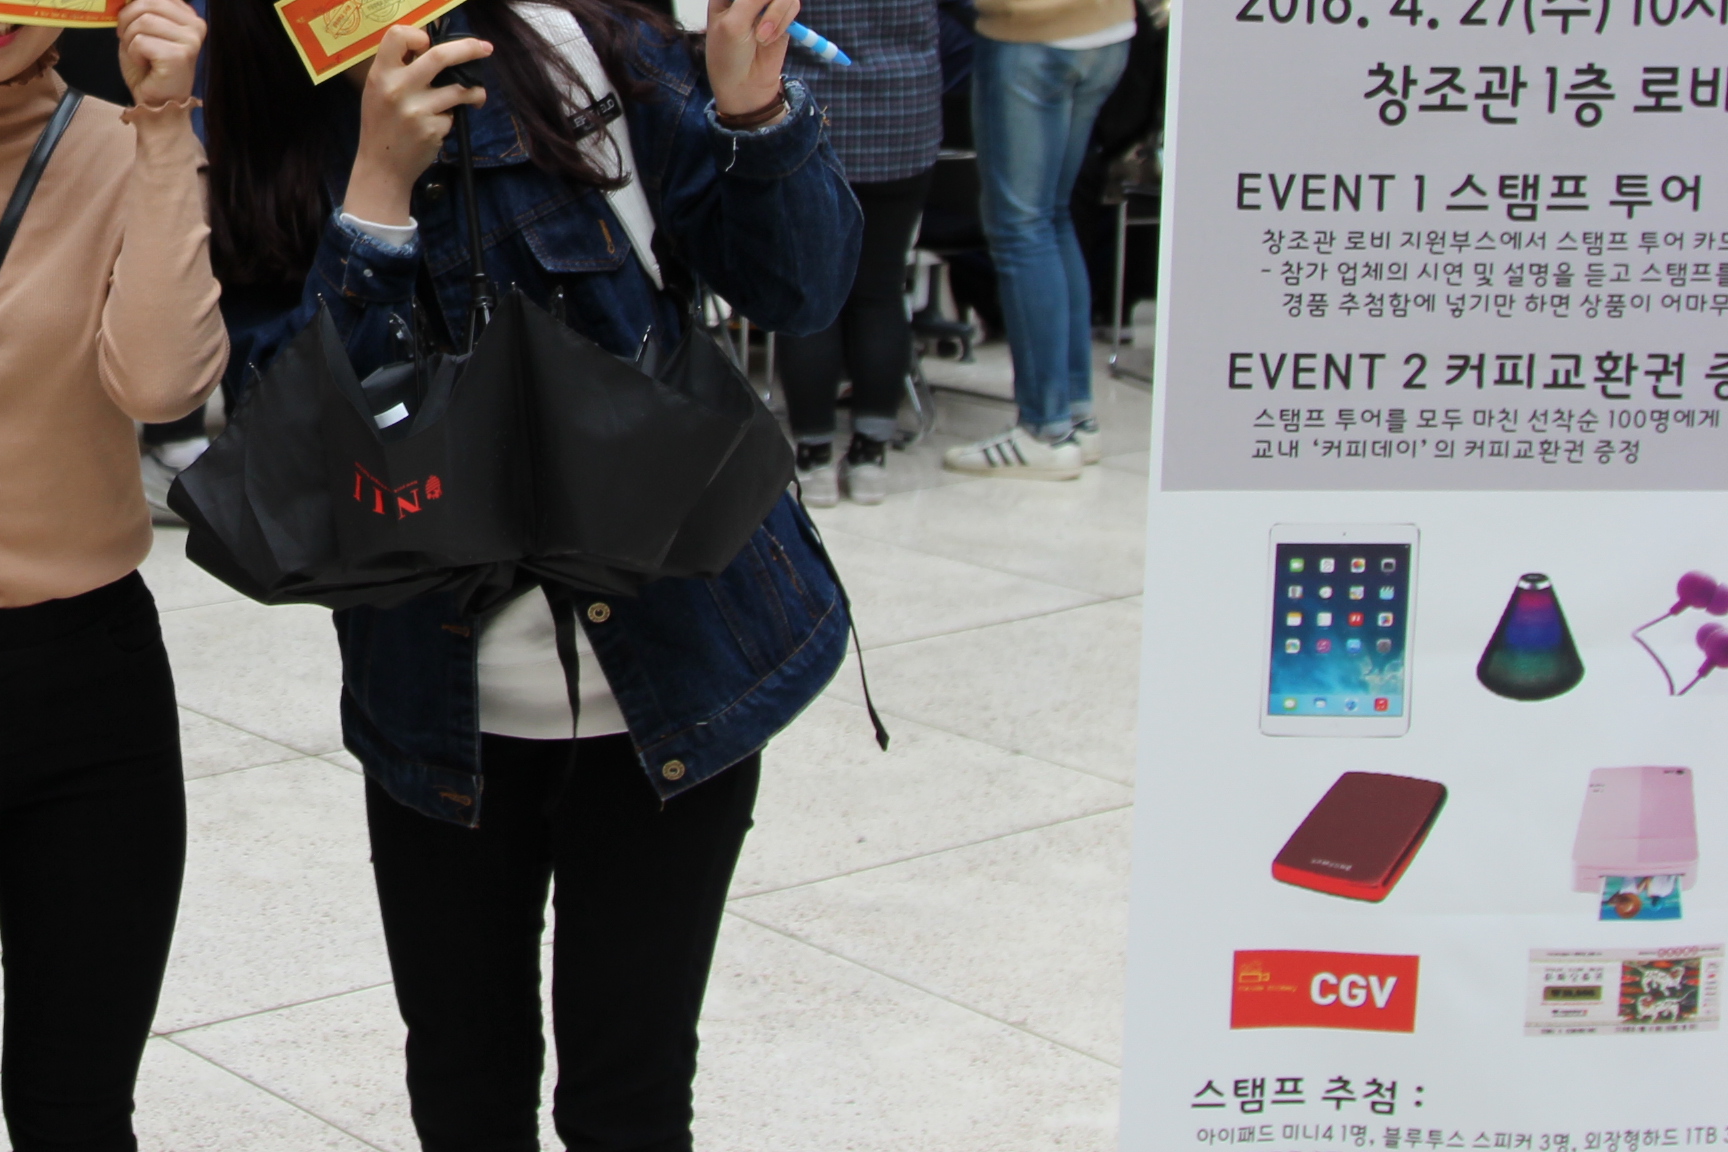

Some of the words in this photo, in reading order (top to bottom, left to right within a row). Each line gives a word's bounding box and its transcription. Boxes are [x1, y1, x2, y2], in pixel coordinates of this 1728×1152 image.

[1364, 61, 1528, 128] 창조관
[1545, 62, 1617, 128] 1층
[1633, 65, 1728, 115] 로비
[1236, 172, 1396, 213] EVENT
[1414, 173, 1425, 213] 1
[1445, 173, 1590, 223] 스탬프
[1608, 173, 1702, 220] 투어
[1261, 229, 1337, 256] 창조관
[1344, 230, 1391, 252] 로비
[1400, 229, 1547, 256] 지원부스에서
[1556, 230, 1630, 256] 스탬프
[1638, 230, 1685, 256] 투어
[1280, 260, 1328, 287] 참가
[1338, 261, 1408, 287] 업체의
[1417, 261, 1464, 286] 시연
[1474, 262, 1495, 287] 및
[1503, 261, 1575, 288] 설명을
[1583, 262, 1632, 286] 듣고
[1282, 292, 1329, 318] 경품
[1338, 292, 1436, 318] 추첨함에
[1445, 292, 1517, 319] 넣기만
[1524, 293, 1571, 317] 하면
[1579, 292, 1652, 318] 상품이
[1228, 351, 1387, 390] EVENT
[1402, 352, 1428, 390] 2
[1444, 350, 1686, 402] 커피교환권
[1253, 407, 1326, 432] 스탬프
[1335, 407, 1408, 432] 투어를
[1416, 409, 1463, 432] 모두
[1473, 408, 1519, 433] 마친
[1527, 408, 1600, 433] 선착순
[1608, 409, 1720, 434] 100명에게
[1251, 438, 1299, 460] 교내
[1464, 438, 1584, 465] 커피교환권
[1593, 439, 1641, 465] 증정
[1309, 971, 1398, 1009] CGV
[1191, 1077, 1306, 1114] 스탬프
[1321, 1075, 1397, 1116] 추첨
[1197, 1124, 1275, 1145] 아이패드
[1282, 1123, 1334, 1142] 미니4
[1383, 1126, 1466, 1149] 블루투스
[1472, 1130, 1532, 1149] 스피커
[1585, 1127, 1678, 1152] 외장형하드
[1686, 1127, 1718, 1145] 1TB
